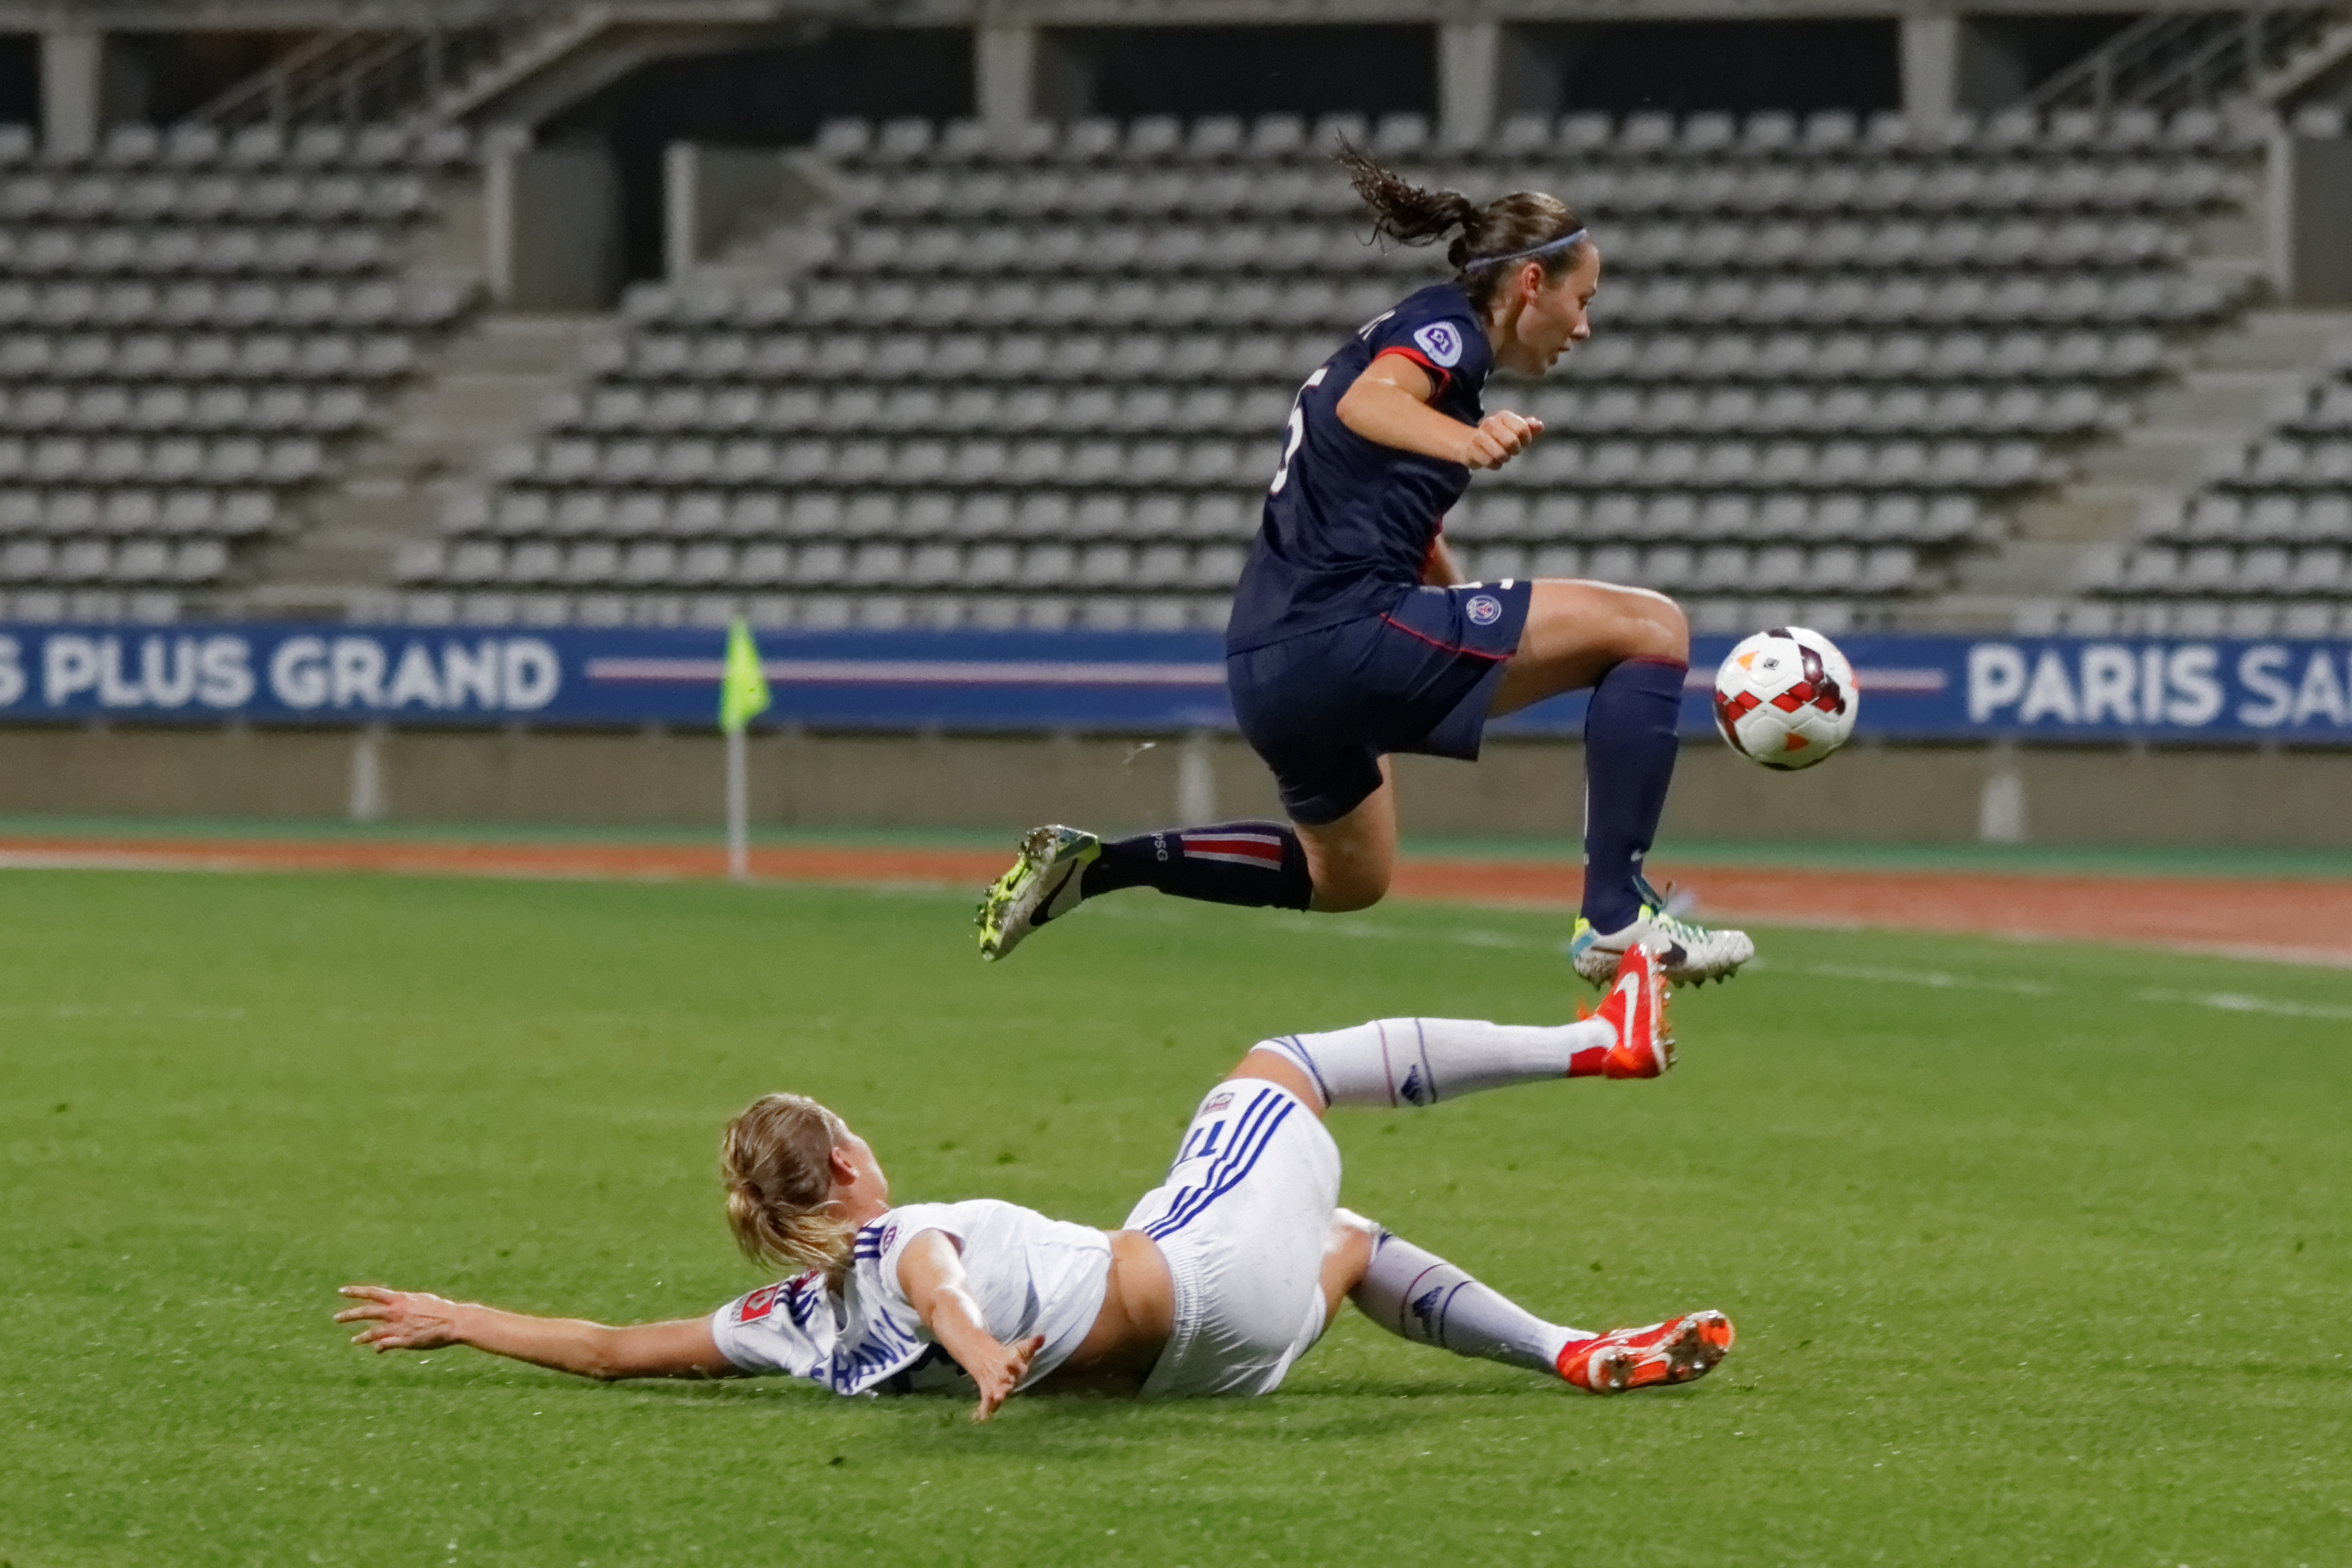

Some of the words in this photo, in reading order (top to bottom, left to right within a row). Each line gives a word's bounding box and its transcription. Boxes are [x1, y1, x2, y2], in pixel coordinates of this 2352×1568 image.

[1430, 328, 1450, 353] D1
[42, 636, 256, 709] PLUS
[270, 636, 560, 710] GRAND
[1966, 642, 2224, 726] PARIS
[2237, 644, 2352, 727] SA
